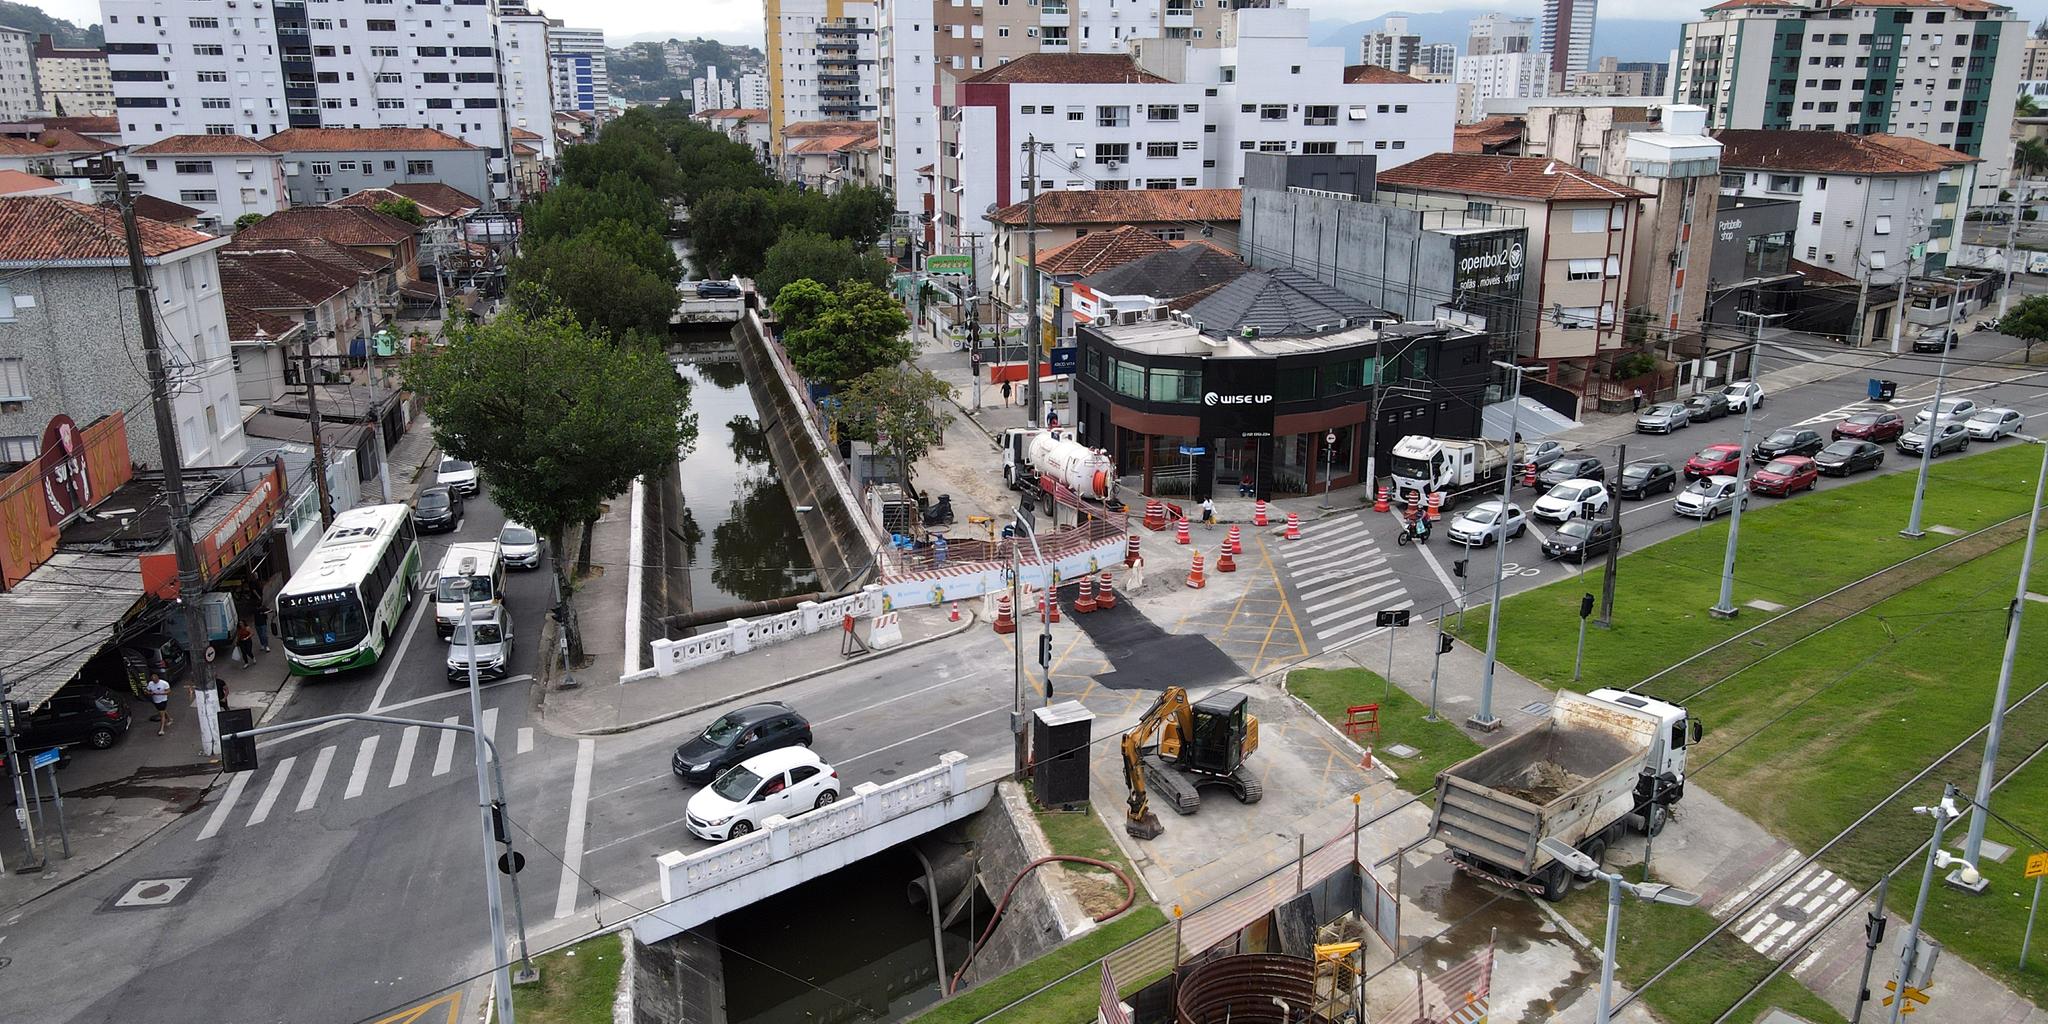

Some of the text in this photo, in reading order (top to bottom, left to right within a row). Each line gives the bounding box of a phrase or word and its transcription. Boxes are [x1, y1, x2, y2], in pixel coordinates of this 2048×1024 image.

[1718, 218, 1742, 231] Portobello
[1720, 231, 1733, 242] shop
[1461, 249, 1508, 274] openbox2
[1460, 278, 1476, 290] sofás
[1480, 275, 1500, 287] móveis
[1220, 395, 1273, 404] WISE UP
